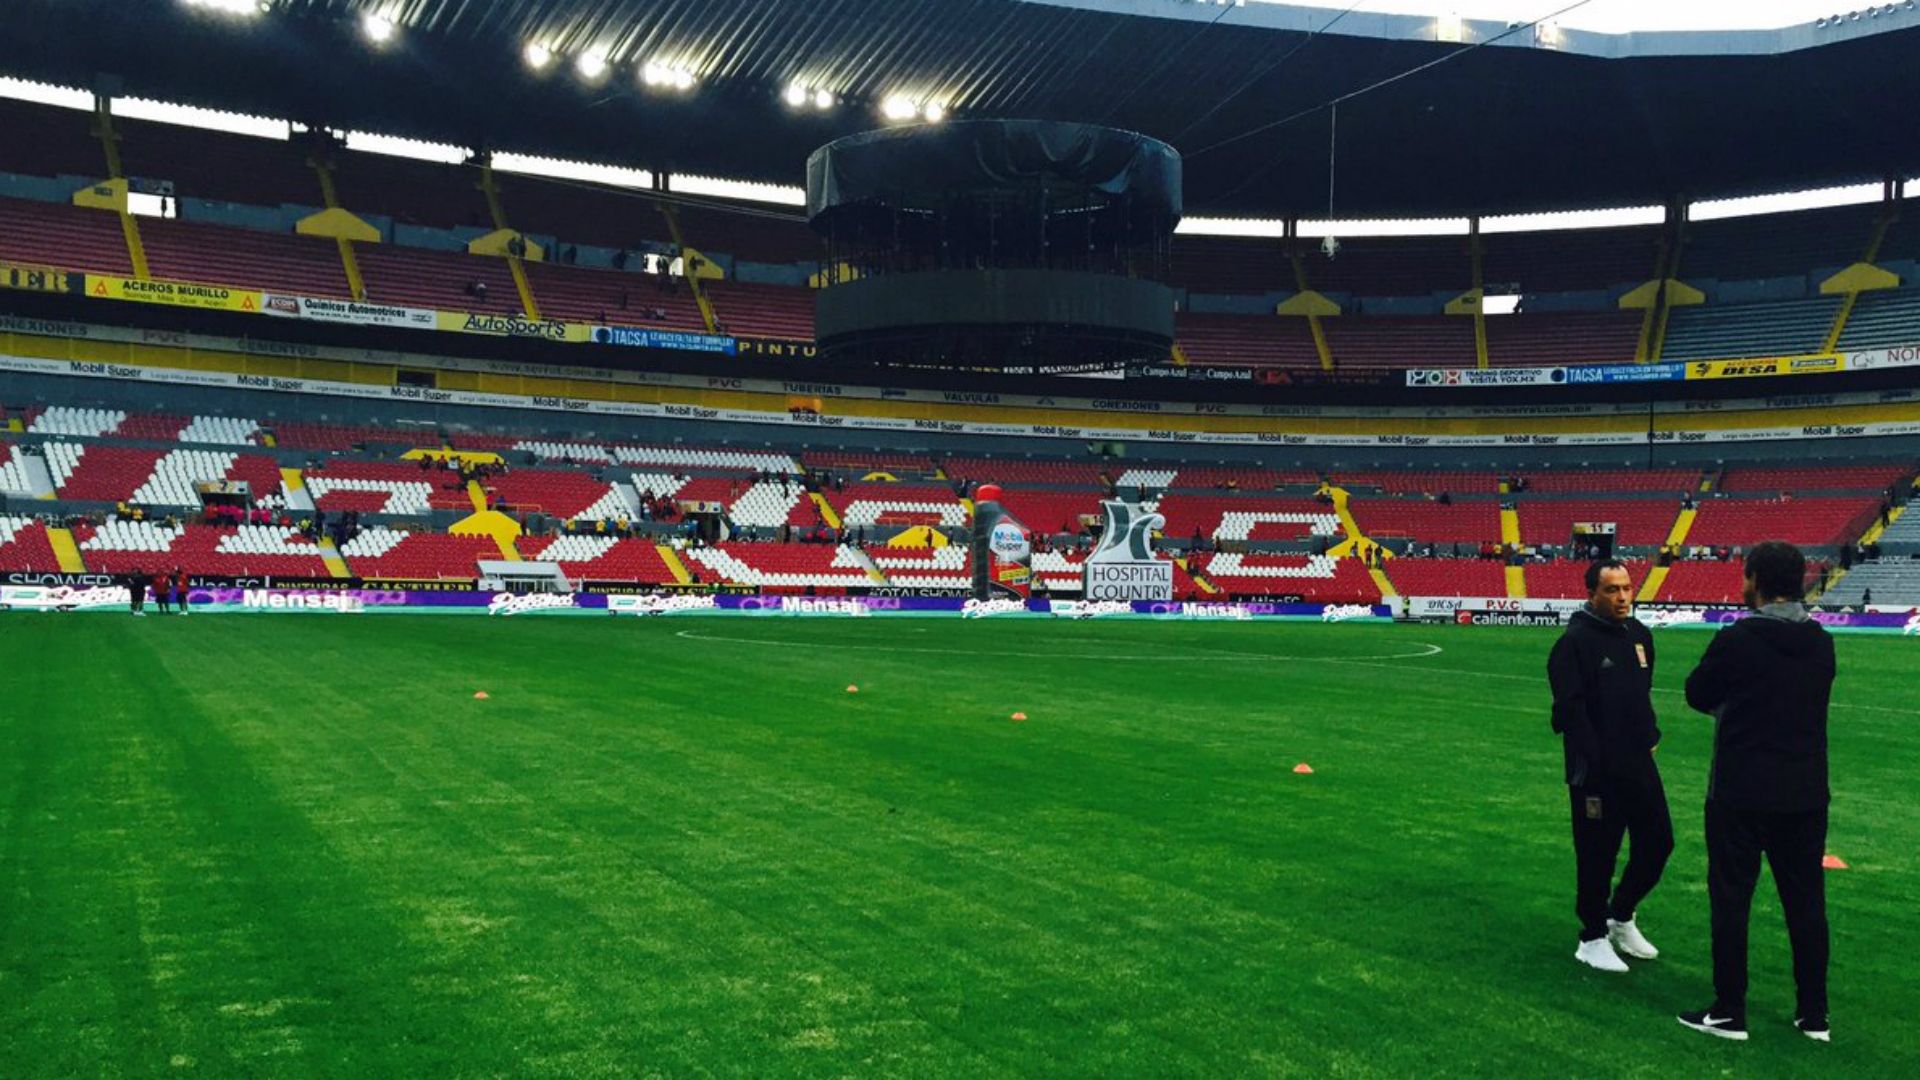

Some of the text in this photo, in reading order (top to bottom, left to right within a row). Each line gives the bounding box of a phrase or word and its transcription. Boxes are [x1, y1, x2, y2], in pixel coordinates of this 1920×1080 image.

[122, 281, 229, 299] ACEROS MURILLO
[348, 303, 406, 318] Automotrices
[0, 317, 88, 336] NEXIONES
[613, 327, 649, 347] TACSA
[70, 361, 105, 374] Mobil
[107, 365, 142, 378] Super
[1569, 367, 1603, 383] TACSA
[237, 374, 269, 386] Mobil
[272, 377, 303, 390] Super
[708, 377, 742, 389] PVC
[390, 386, 420, 397] Mobil
[422, 389, 452, 401] Super
[532, 397, 560, 408] Mobil
[562, 399, 590, 410] Super
[1092, 400, 1161, 411] CONEXIONES
[1195, 402, 1227, 413] PVC
[665, 405, 691, 416] Mobil
[692, 407, 718, 418] Super
[792, 412, 818, 423] Mobil
[818, 415, 844, 425] Super
[915, 419, 939, 429] Mobil
[940, 421, 964, 431] Super
[1033, 425, 1056, 435] Mobil
[1058, 427, 1081, 436] Super
[1148, 430, 1171, 439] Mobil
[1173, 431, 1196, 441] Super
[1646, 431, 1706, 441] Mobil Super
[1802, 426, 1865, 437] Mobil Super
[1258, 433, 1281, 442] Mobil
[1283, 434, 1307, 444] Super
[1378, 435, 1403, 444] Mobil
[1405, 436, 1430, 445] Super
[1504, 435, 1559, 444] Mobil Super
[1092, 566, 1169, 582] HOSPITAL
[1092, 585, 1171, 600] COUNTRY
[1472, 612, 1558, 626] caliente.mx
